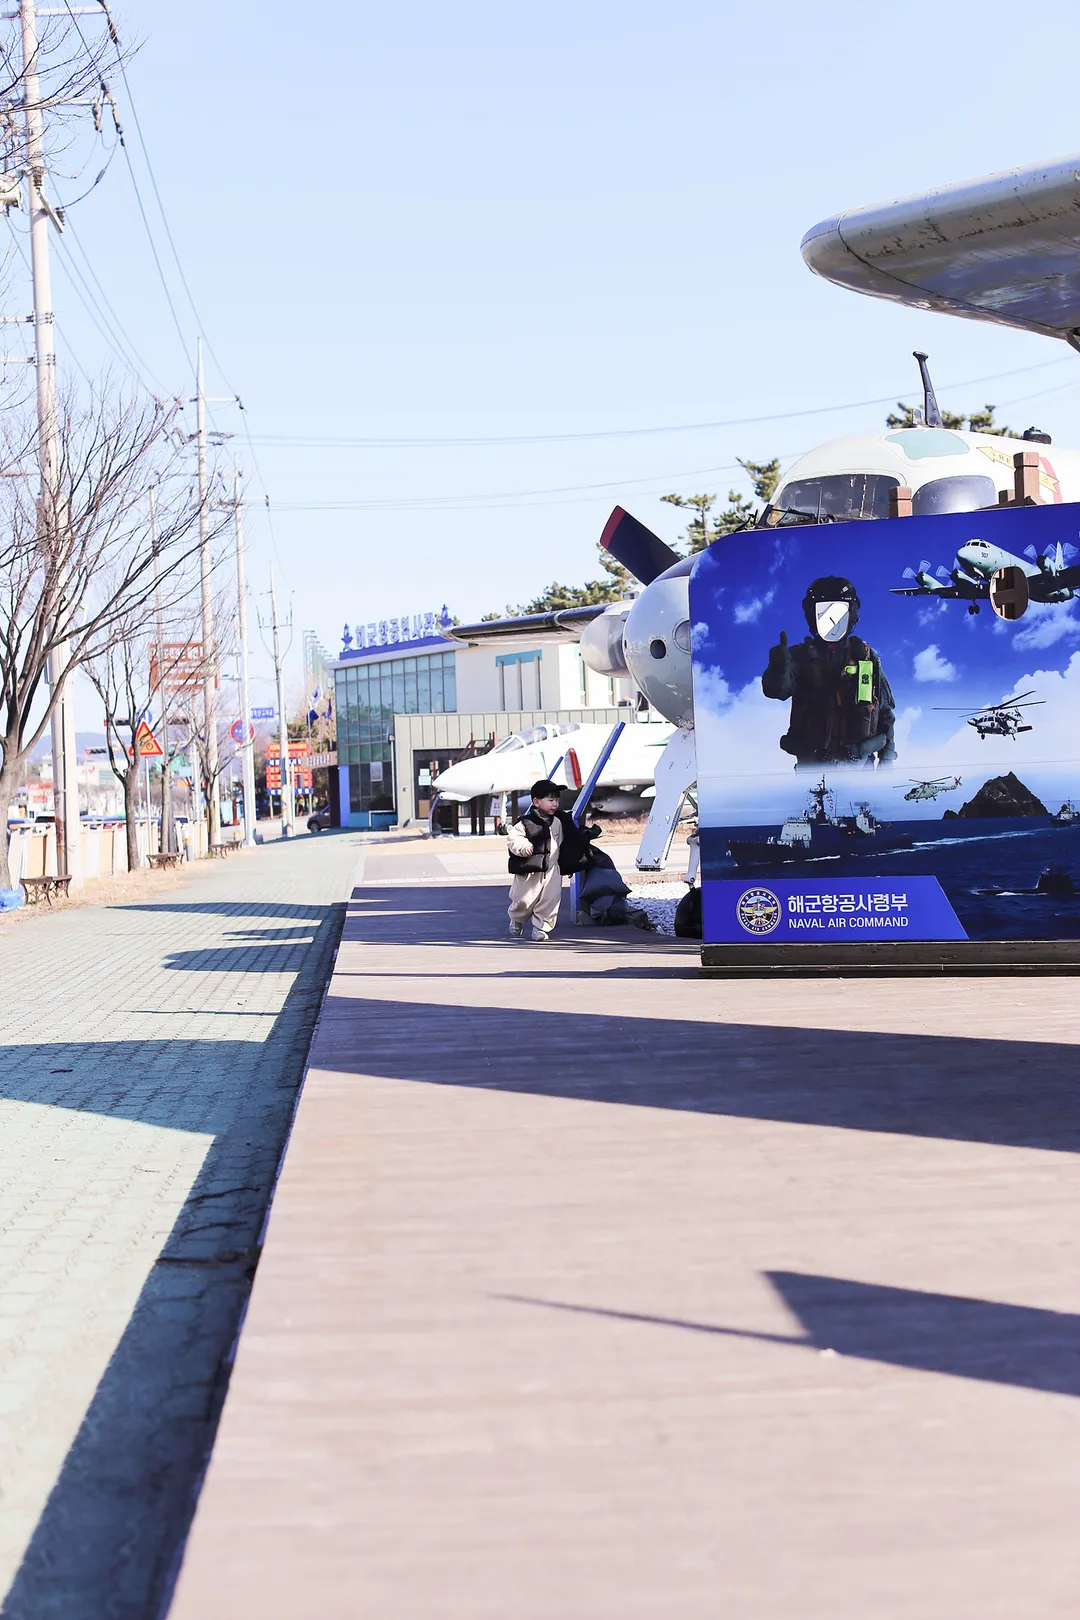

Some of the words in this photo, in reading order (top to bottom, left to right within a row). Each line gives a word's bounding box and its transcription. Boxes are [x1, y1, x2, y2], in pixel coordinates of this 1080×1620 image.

[355, 612, 435, 648] 해군항공역사관
[788, 894, 908, 913] 해군항공사령부
[788, 918, 825, 929] NAVAL
[827, 917, 846, 928] AIR
[849, 916, 909, 928] COMMAND
